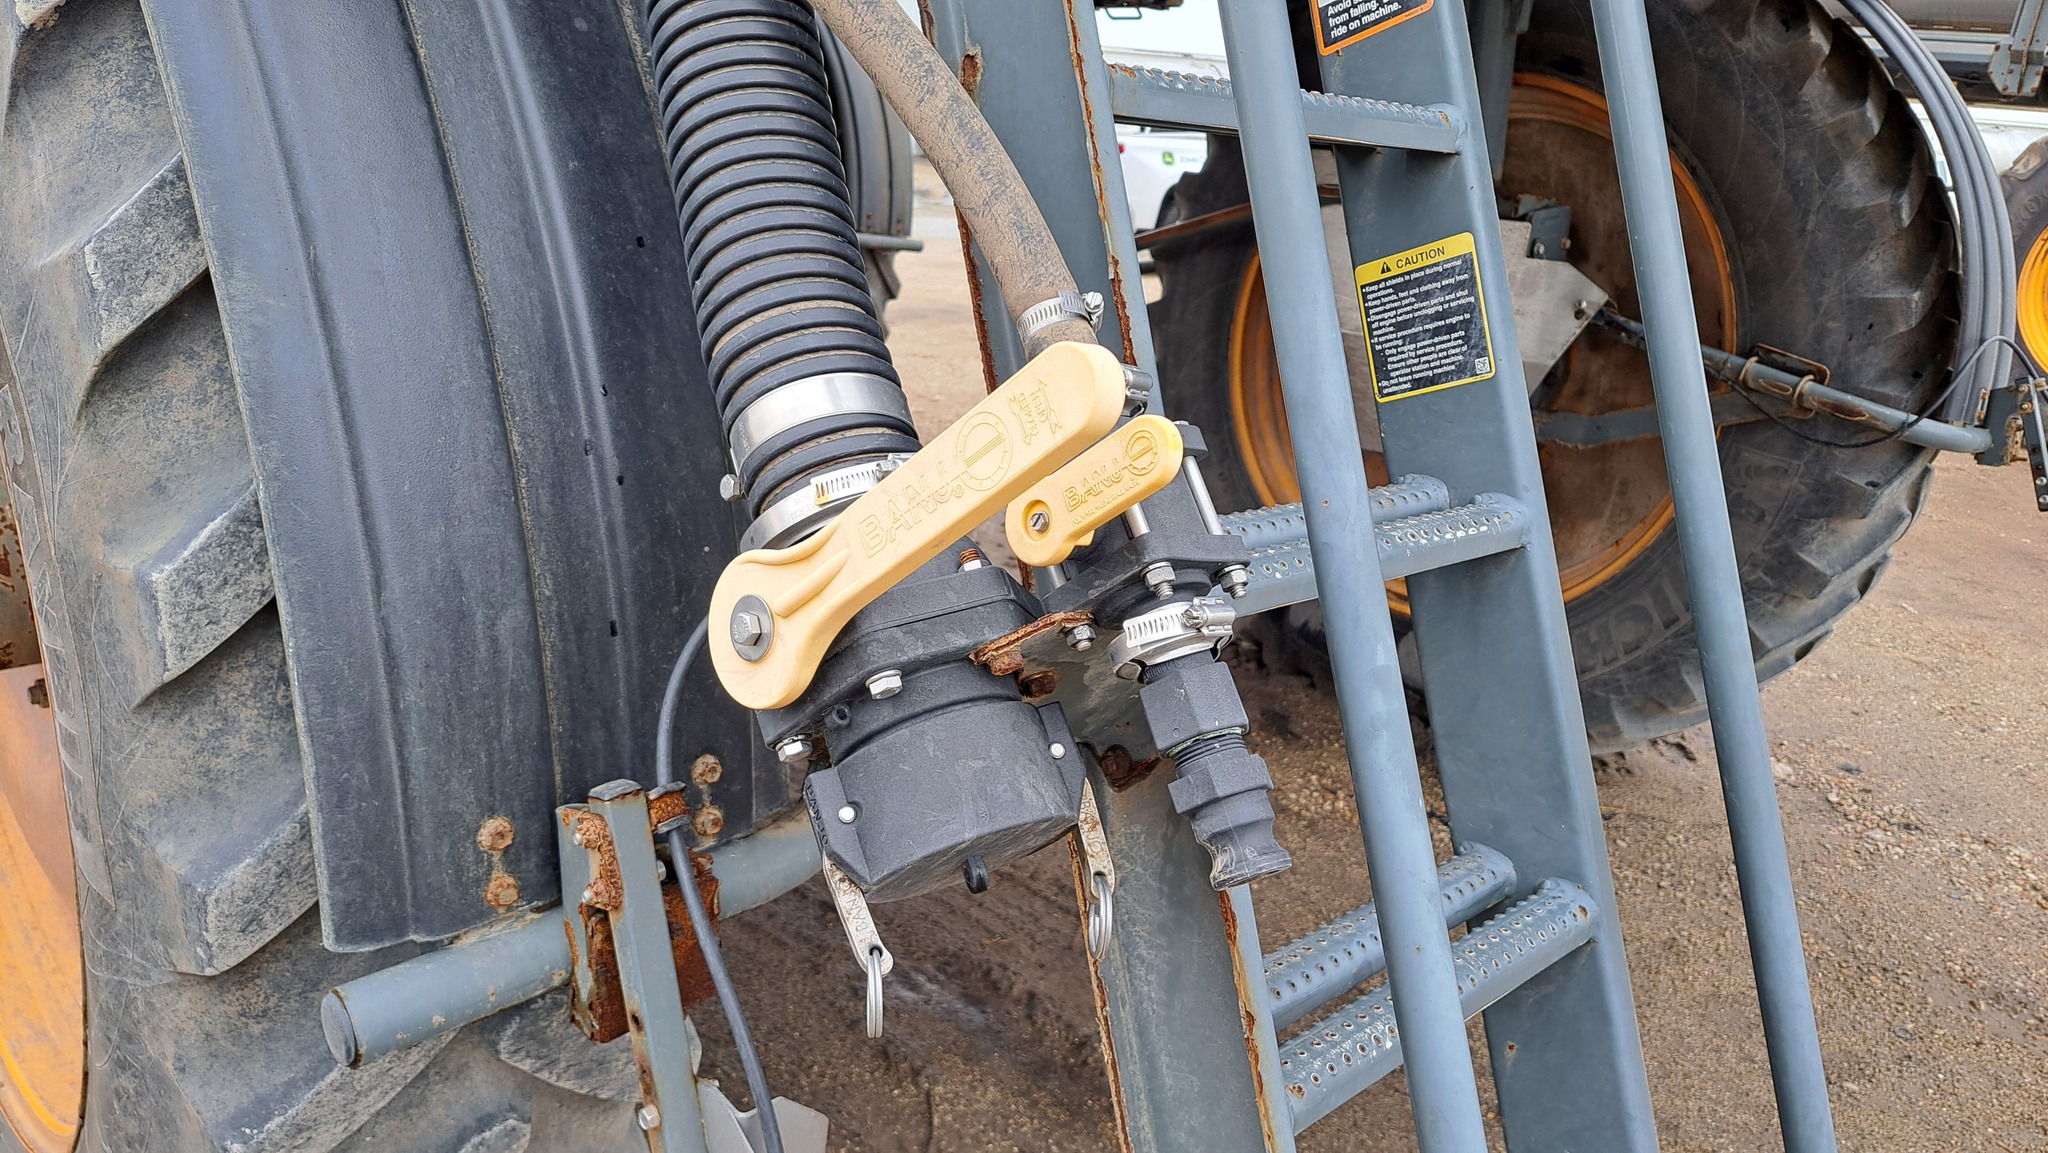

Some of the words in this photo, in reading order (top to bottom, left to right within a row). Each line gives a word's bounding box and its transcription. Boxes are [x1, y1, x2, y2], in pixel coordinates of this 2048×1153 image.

[1327, 0, 1352, 16] Avoid
[1328, 12, 1349, 27] from
[1349, 1, 1379, 17] falling.
[1330, 25, 1348, 38] ride
[1348, 18, 1360, 30] on
[1361, 2, 1402, 24] machine.
[1396, 247, 1445, 268] CAUTION
[1366, 283, 1378, 293] Keep
[1386, 276, 1403, 285] shields
[1411, 269, 1424, 280] place
[1425, 265, 1442, 274] during
[1444, 259, 1462, 268] normal
[1367, 287, 1394, 299] operations.
[1368, 298, 1381, 307] Keep
[1420, 282, 1440, 292] clothing
[1456, 272, 1468, 281] from
[1369, 301, 1401, 313] power-driven
[1402, 296, 1416, 305] parts.
[1371, 310, 1396, 320] Disengage
[1397, 300, 1429, 313] power-driven
[1431, 296, 1444, 304] parts
[1444, 292, 1454, 300] and
[1456, 289, 1468, 297] shut
[1380, 317, 1396, 327] engine
[1397, 312, 1413, 321] before
[1414, 305, 1442, 316] unclogging
[1450, 296, 1474, 306] servicing
[1373, 326, 1395, 334] machine.
[1397, 326, 1423, 336] procedure
[1424, 320, 1445, 329] requires
[1446, 315, 1463, 324] engine
[1385, 347, 1396, 356] Only
[1398, 344, 1416, 352] engage
[1417, 334, 1450, 347] power-driven
[1451, 330, 1465, 339] parts
[1436, 339, 1464, 350] procedure.
[1390, 368, 1411, 376] operator
[1441, 354, 1464, 363] machine.
[1406, 357, 1419, 365] other
[1421, 353, 1438, 361] people
[1399, 374, 1412, 382] leave
[1413, 370, 1432, 378] running
[1383, 382, 1411, 392] unattended.
[806, 784, 829, 845] BANJO
[1081, 800, 1102, 853] BANJO
